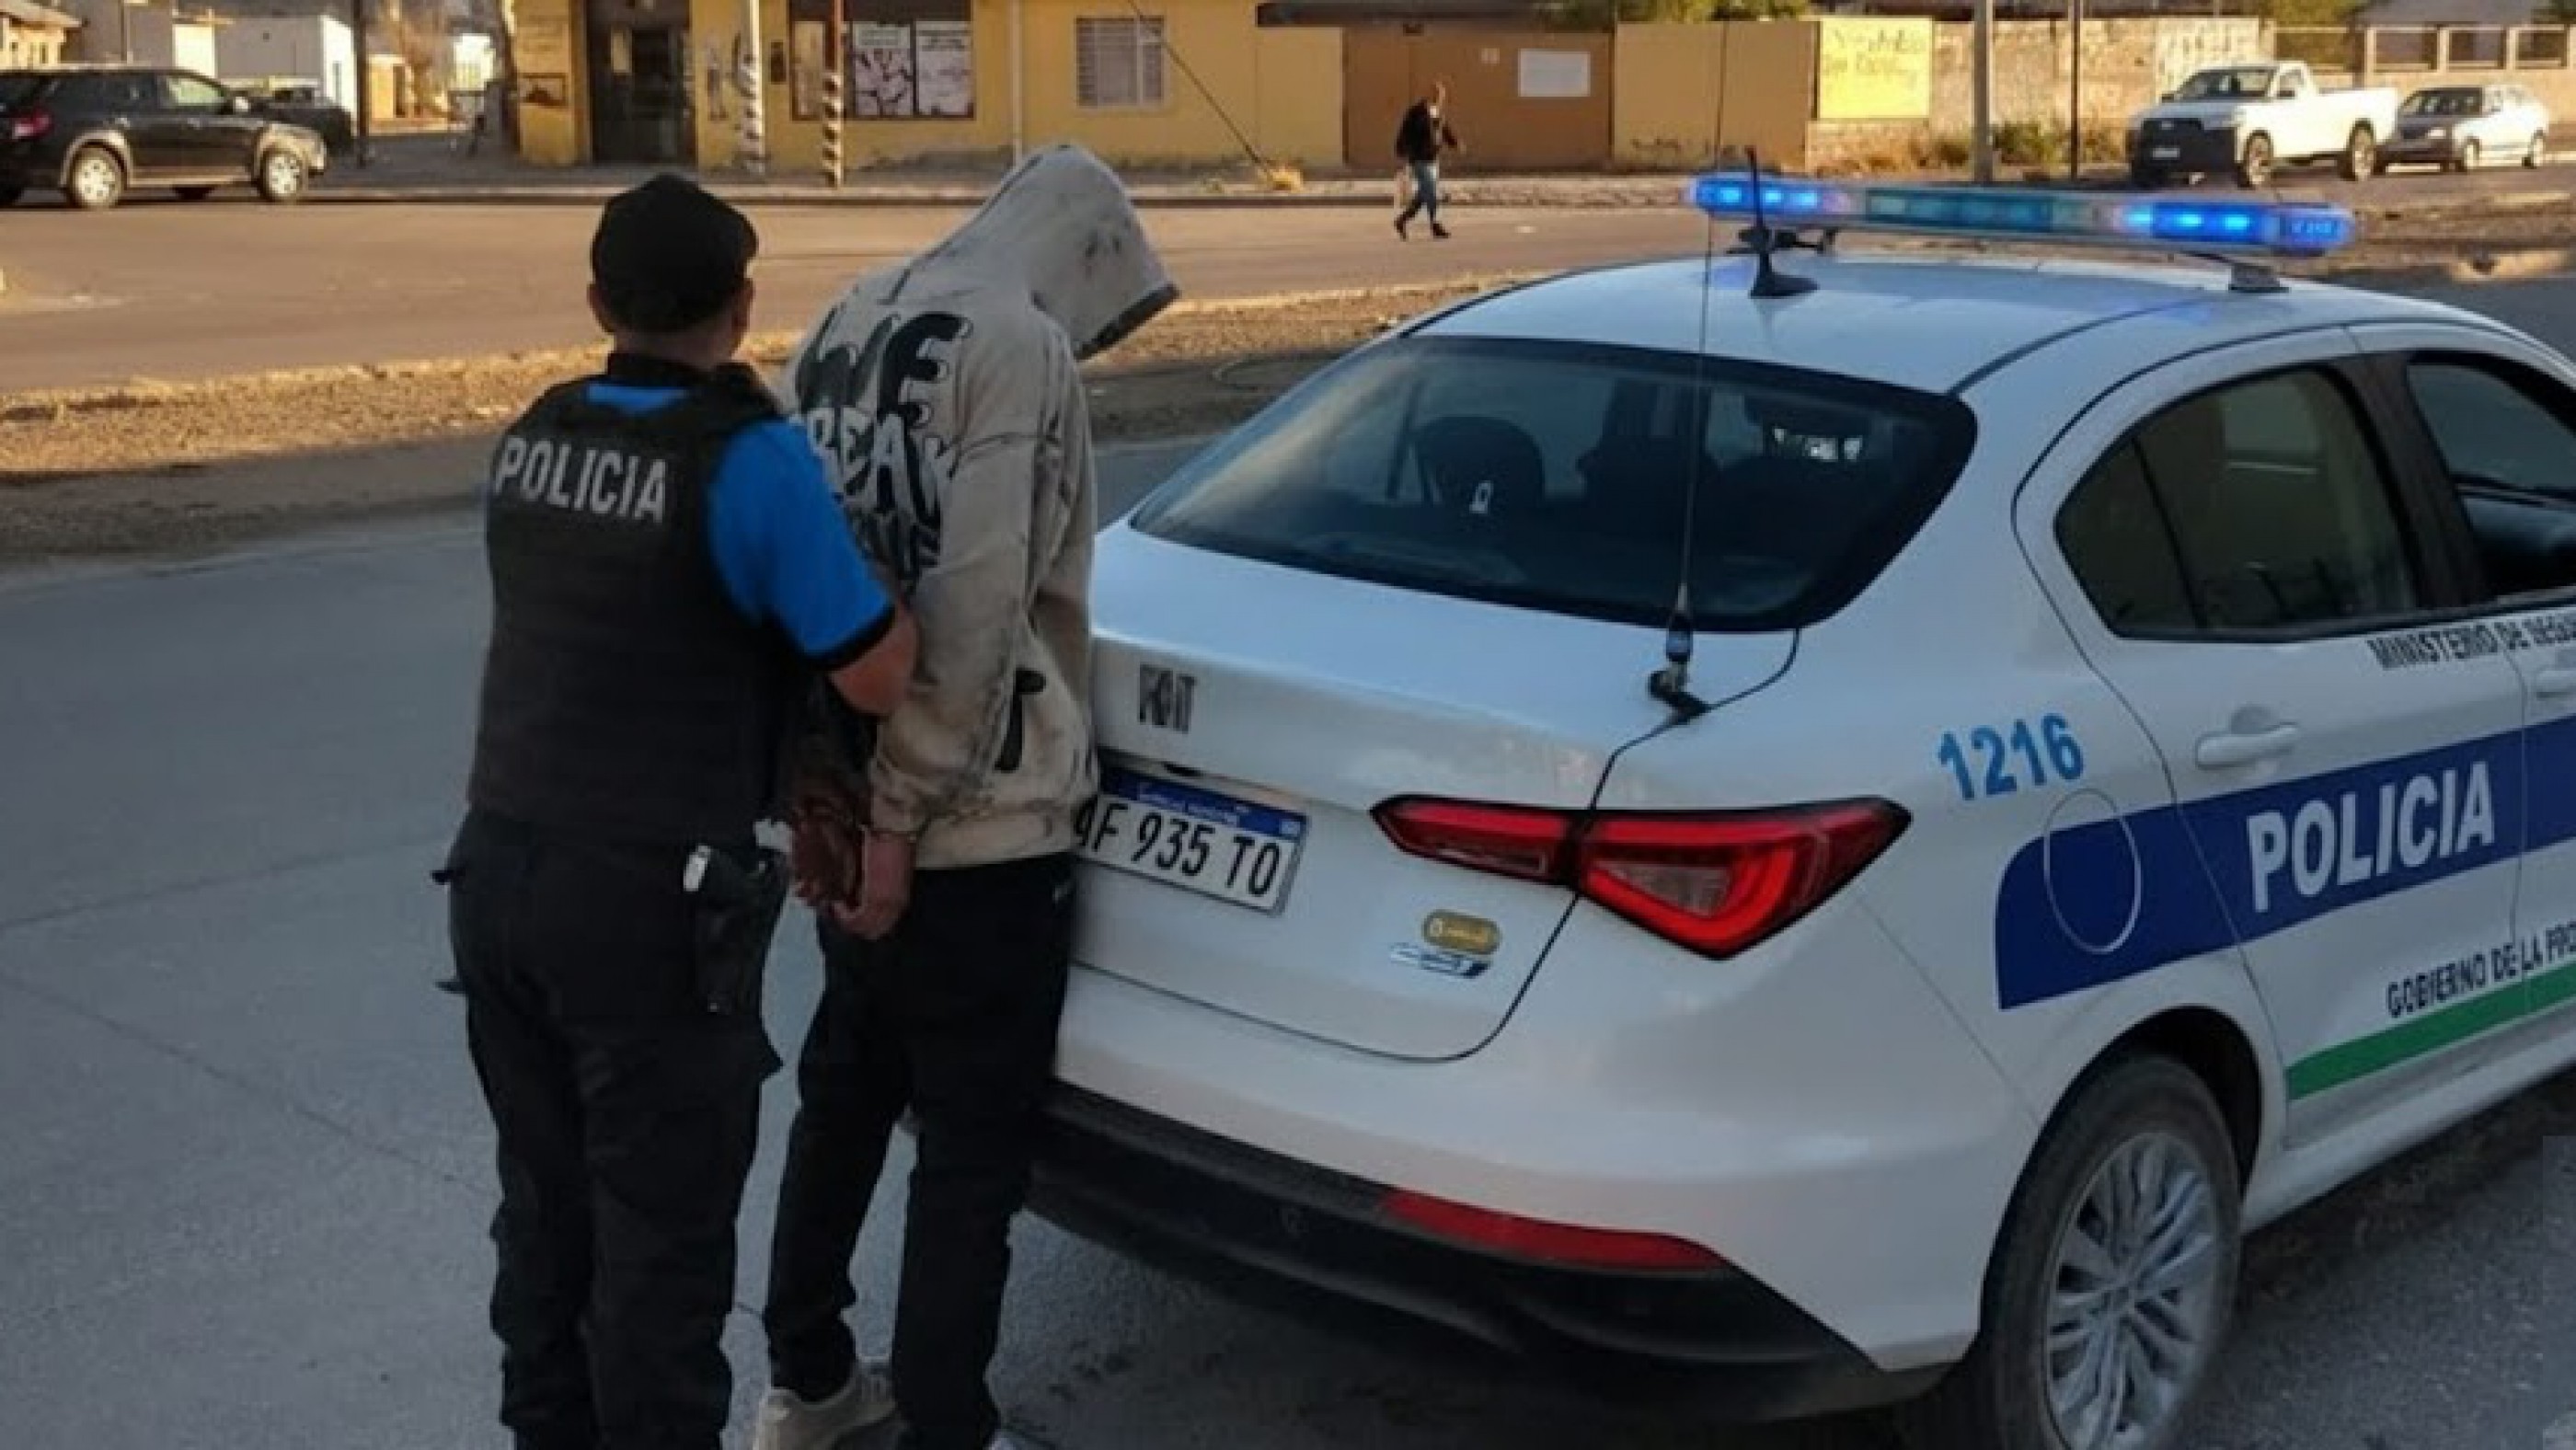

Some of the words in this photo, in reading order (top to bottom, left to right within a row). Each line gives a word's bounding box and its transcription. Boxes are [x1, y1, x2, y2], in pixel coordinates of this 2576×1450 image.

[494, 435, 668, 524] POLICIA
[1938, 712, 2084, 801] 1216
[1131, 811, 1216, 876] 935
[2247, 760, 2495, 914] POLICIA
[2386, 951, 2487, 1018] GOBIERNO
[2490, 941, 2519, 984] DE
[2519, 933, 2545, 972] LA
